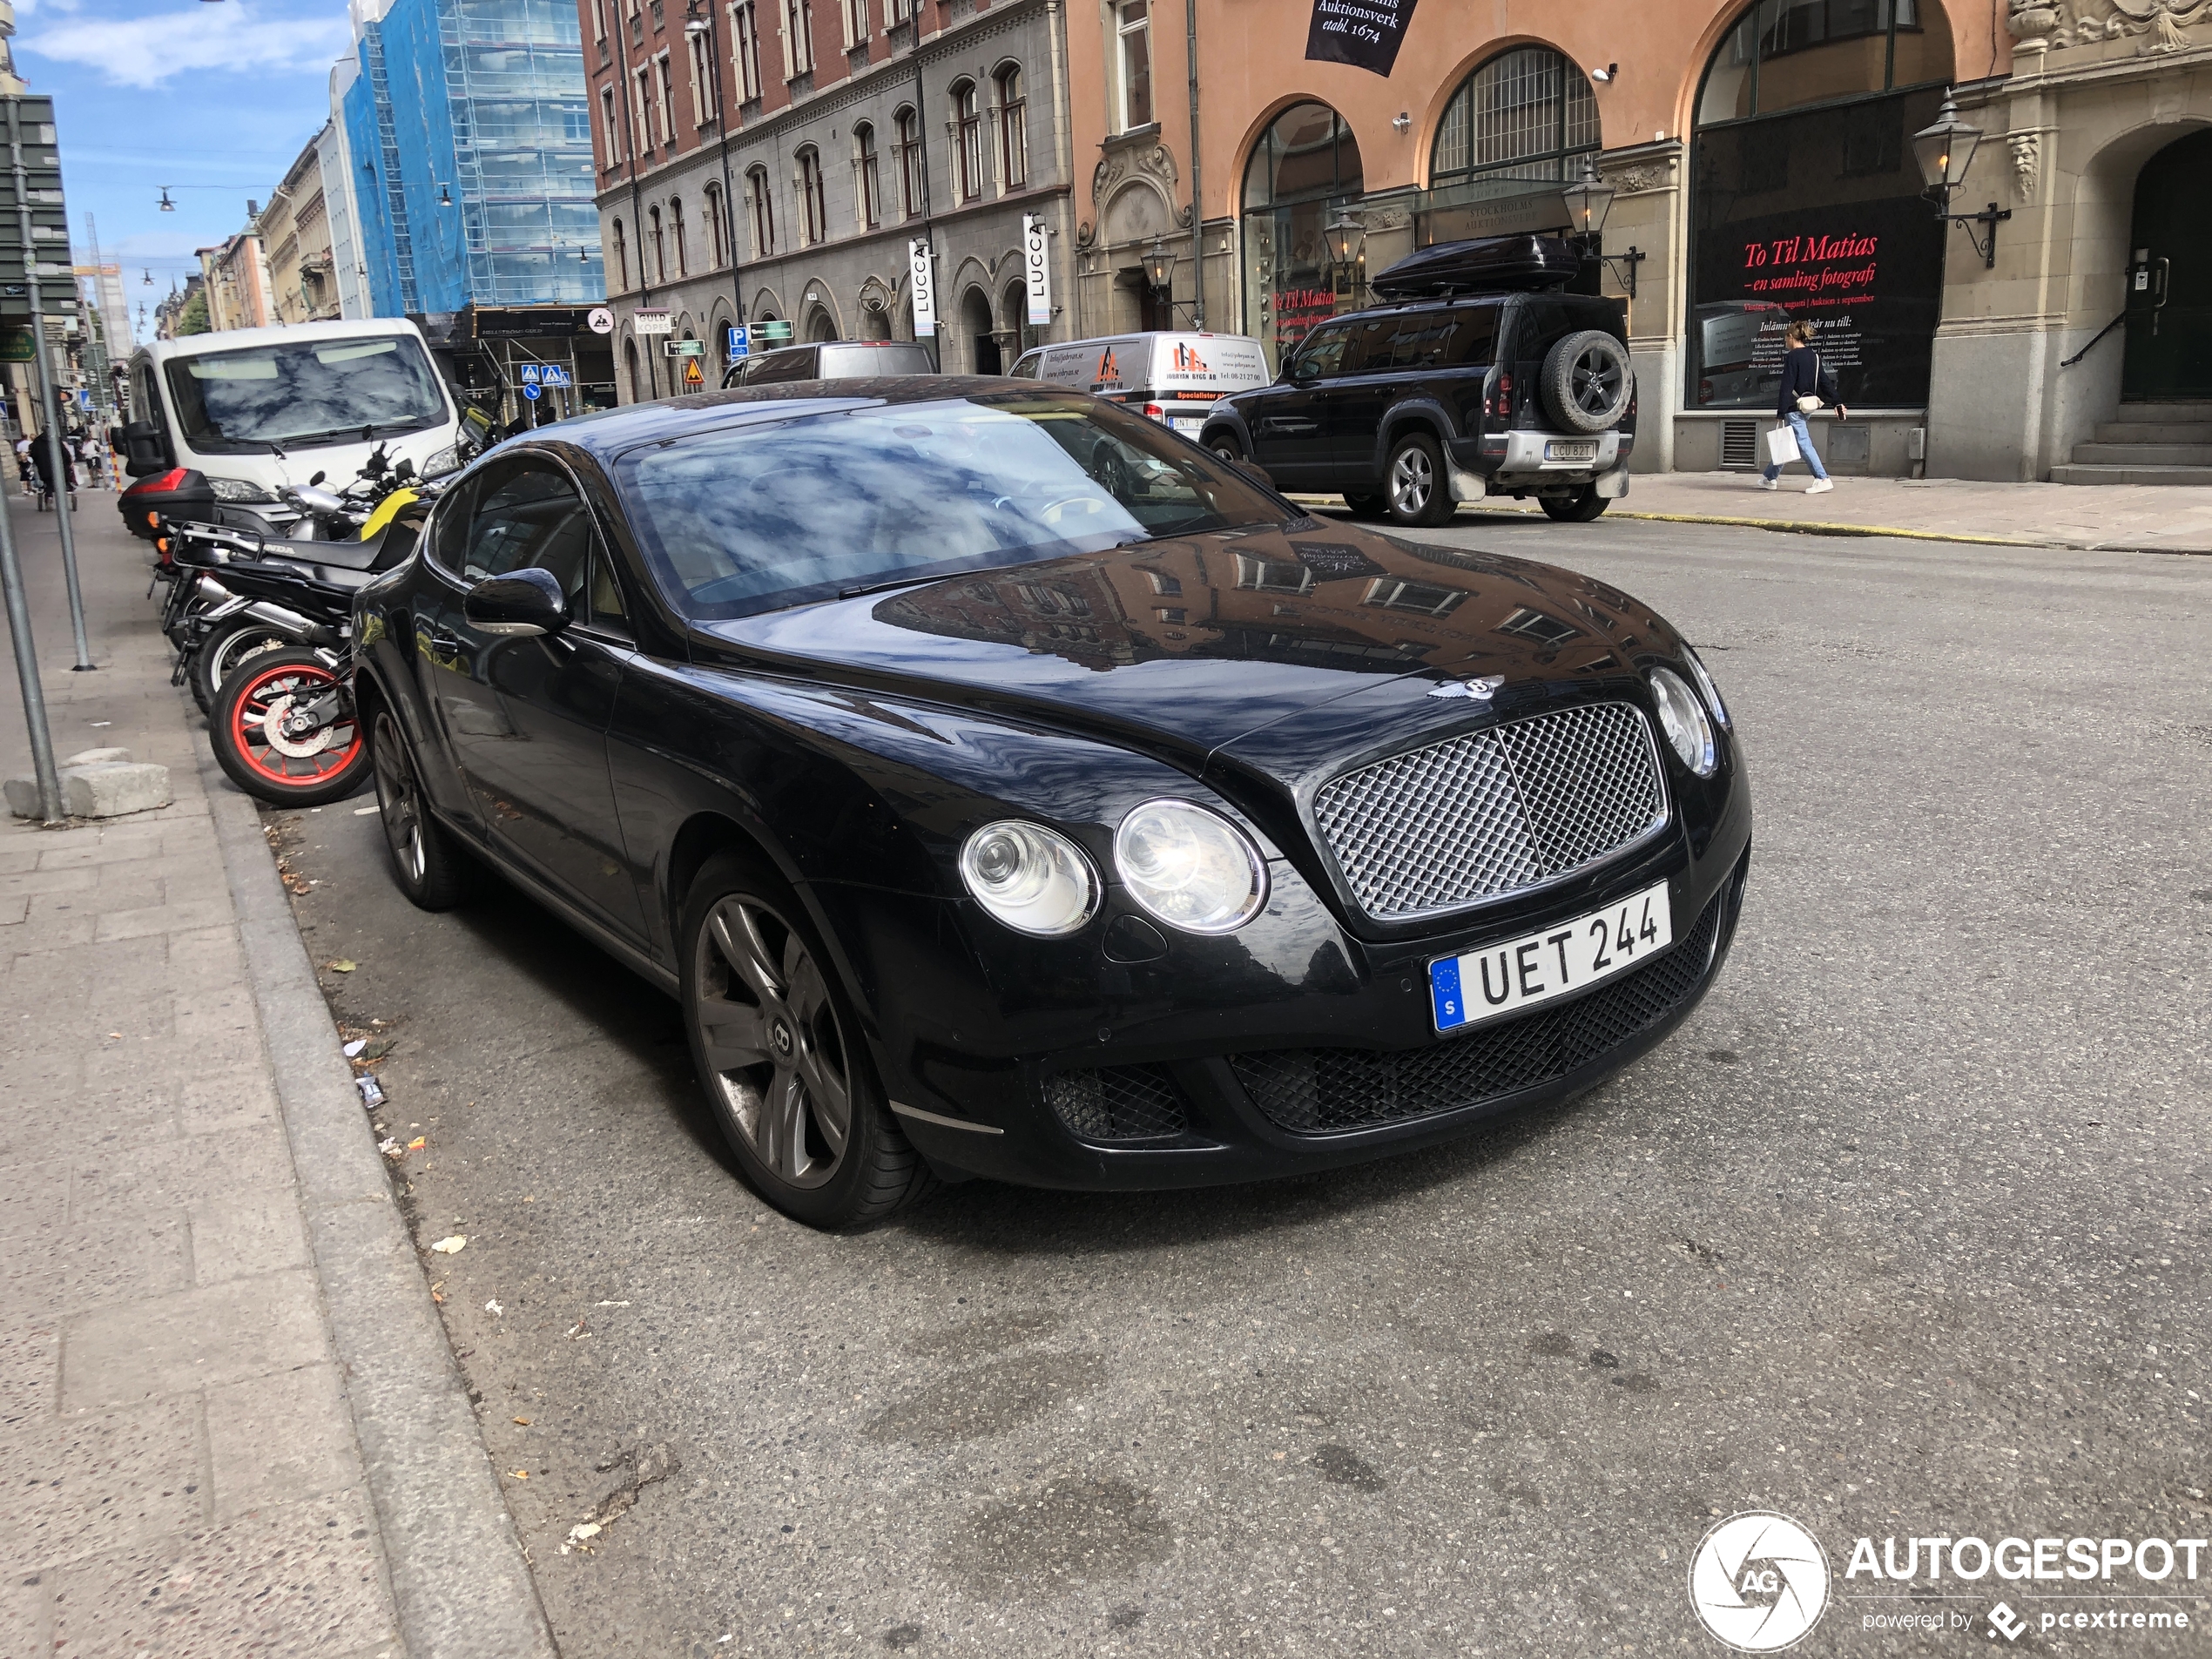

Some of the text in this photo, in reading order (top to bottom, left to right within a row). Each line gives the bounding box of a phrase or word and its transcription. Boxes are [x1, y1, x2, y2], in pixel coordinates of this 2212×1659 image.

[1318, 0, 1399, 29] Auktionsverk
[1322, 17, 1381, 44] etabl. 1674
[1470, 200, 1533, 218] STOCKHOLMS
[1465, 211, 1539, 231] AUKTIONSVERK
[1744, 232, 1878, 268] To Til Matias
[1029, 224, 1045, 297] LUCCA
[914, 246, 929, 313] LUCCA
[1770, 270, 1820, 292] samling
[1818, 262, 1877, 292] fotografi
[1285, 288, 1299, 309] Til
[1299, 288, 1337, 308] Matias
[1784, 299, 1806, 310] augusti
[1811, 297, 1836, 307] Auktion
[1841, 293, 1875, 306] september
[637, 322, 670, 332] KÖPES
[639, 314, 666, 322] GULD
[1824, 320, 1836, 328] nu
[1837, 315, 1852, 327] till:
[733, 330, 745, 345] P
[1554, 445, 1590, 456] LCU 82T
[1480, 896, 1657, 1005] UET 244
[1445, 1001, 1455, 1015] S
